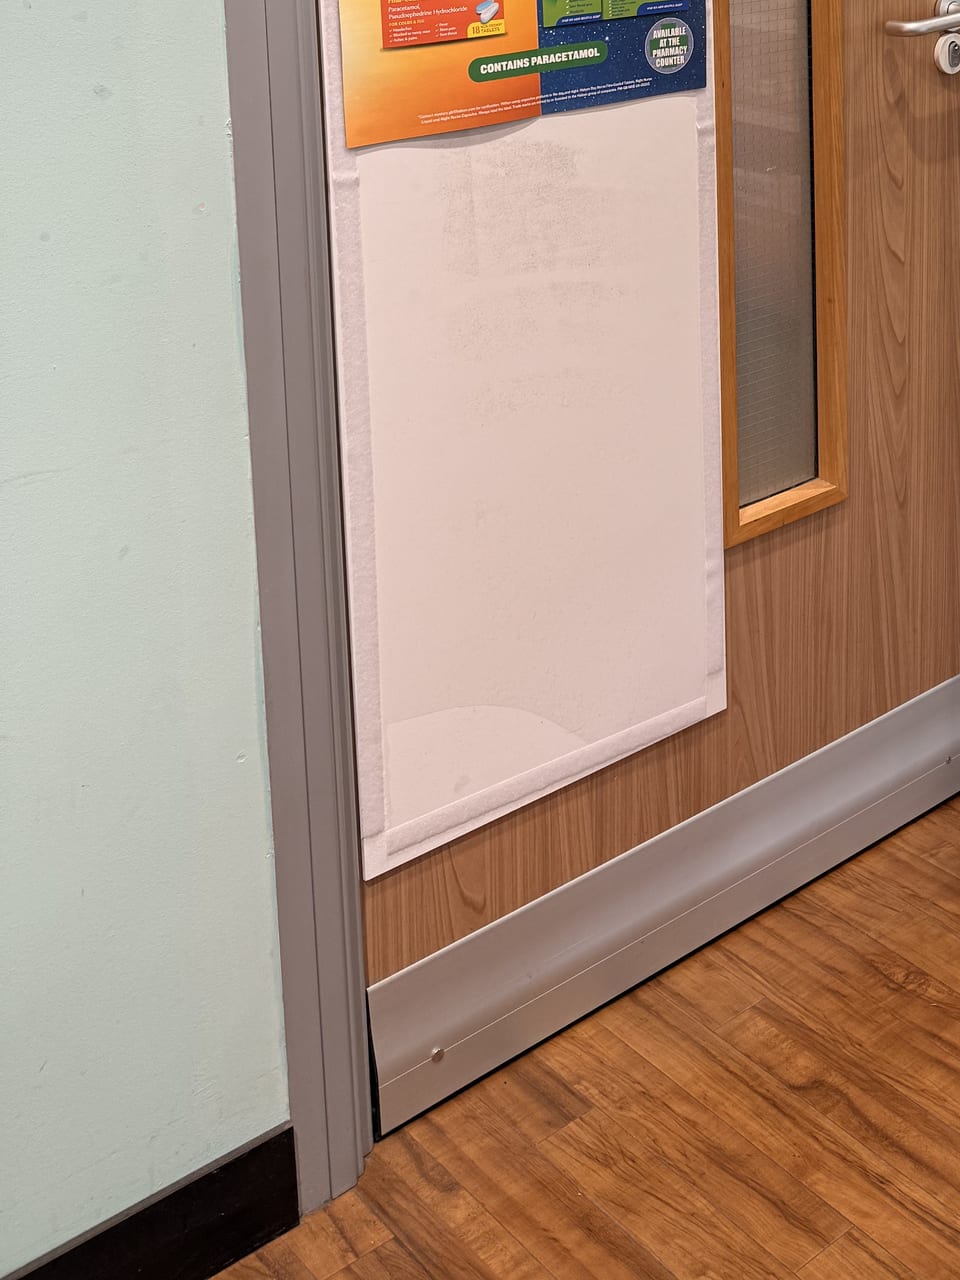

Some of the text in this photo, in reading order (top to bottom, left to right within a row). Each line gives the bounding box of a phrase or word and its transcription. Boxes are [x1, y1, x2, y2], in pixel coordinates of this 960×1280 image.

[472, 26, 480, 34] 18
[652, 26, 687, 39] AVAILABLE
[659, 37, 680, 46] AT THE
[652, 46, 688, 57] PHARMACY
[480, 48, 600, 74] CONTAINS PARACETAMOL
[655, 56, 685, 67] COUNTER
